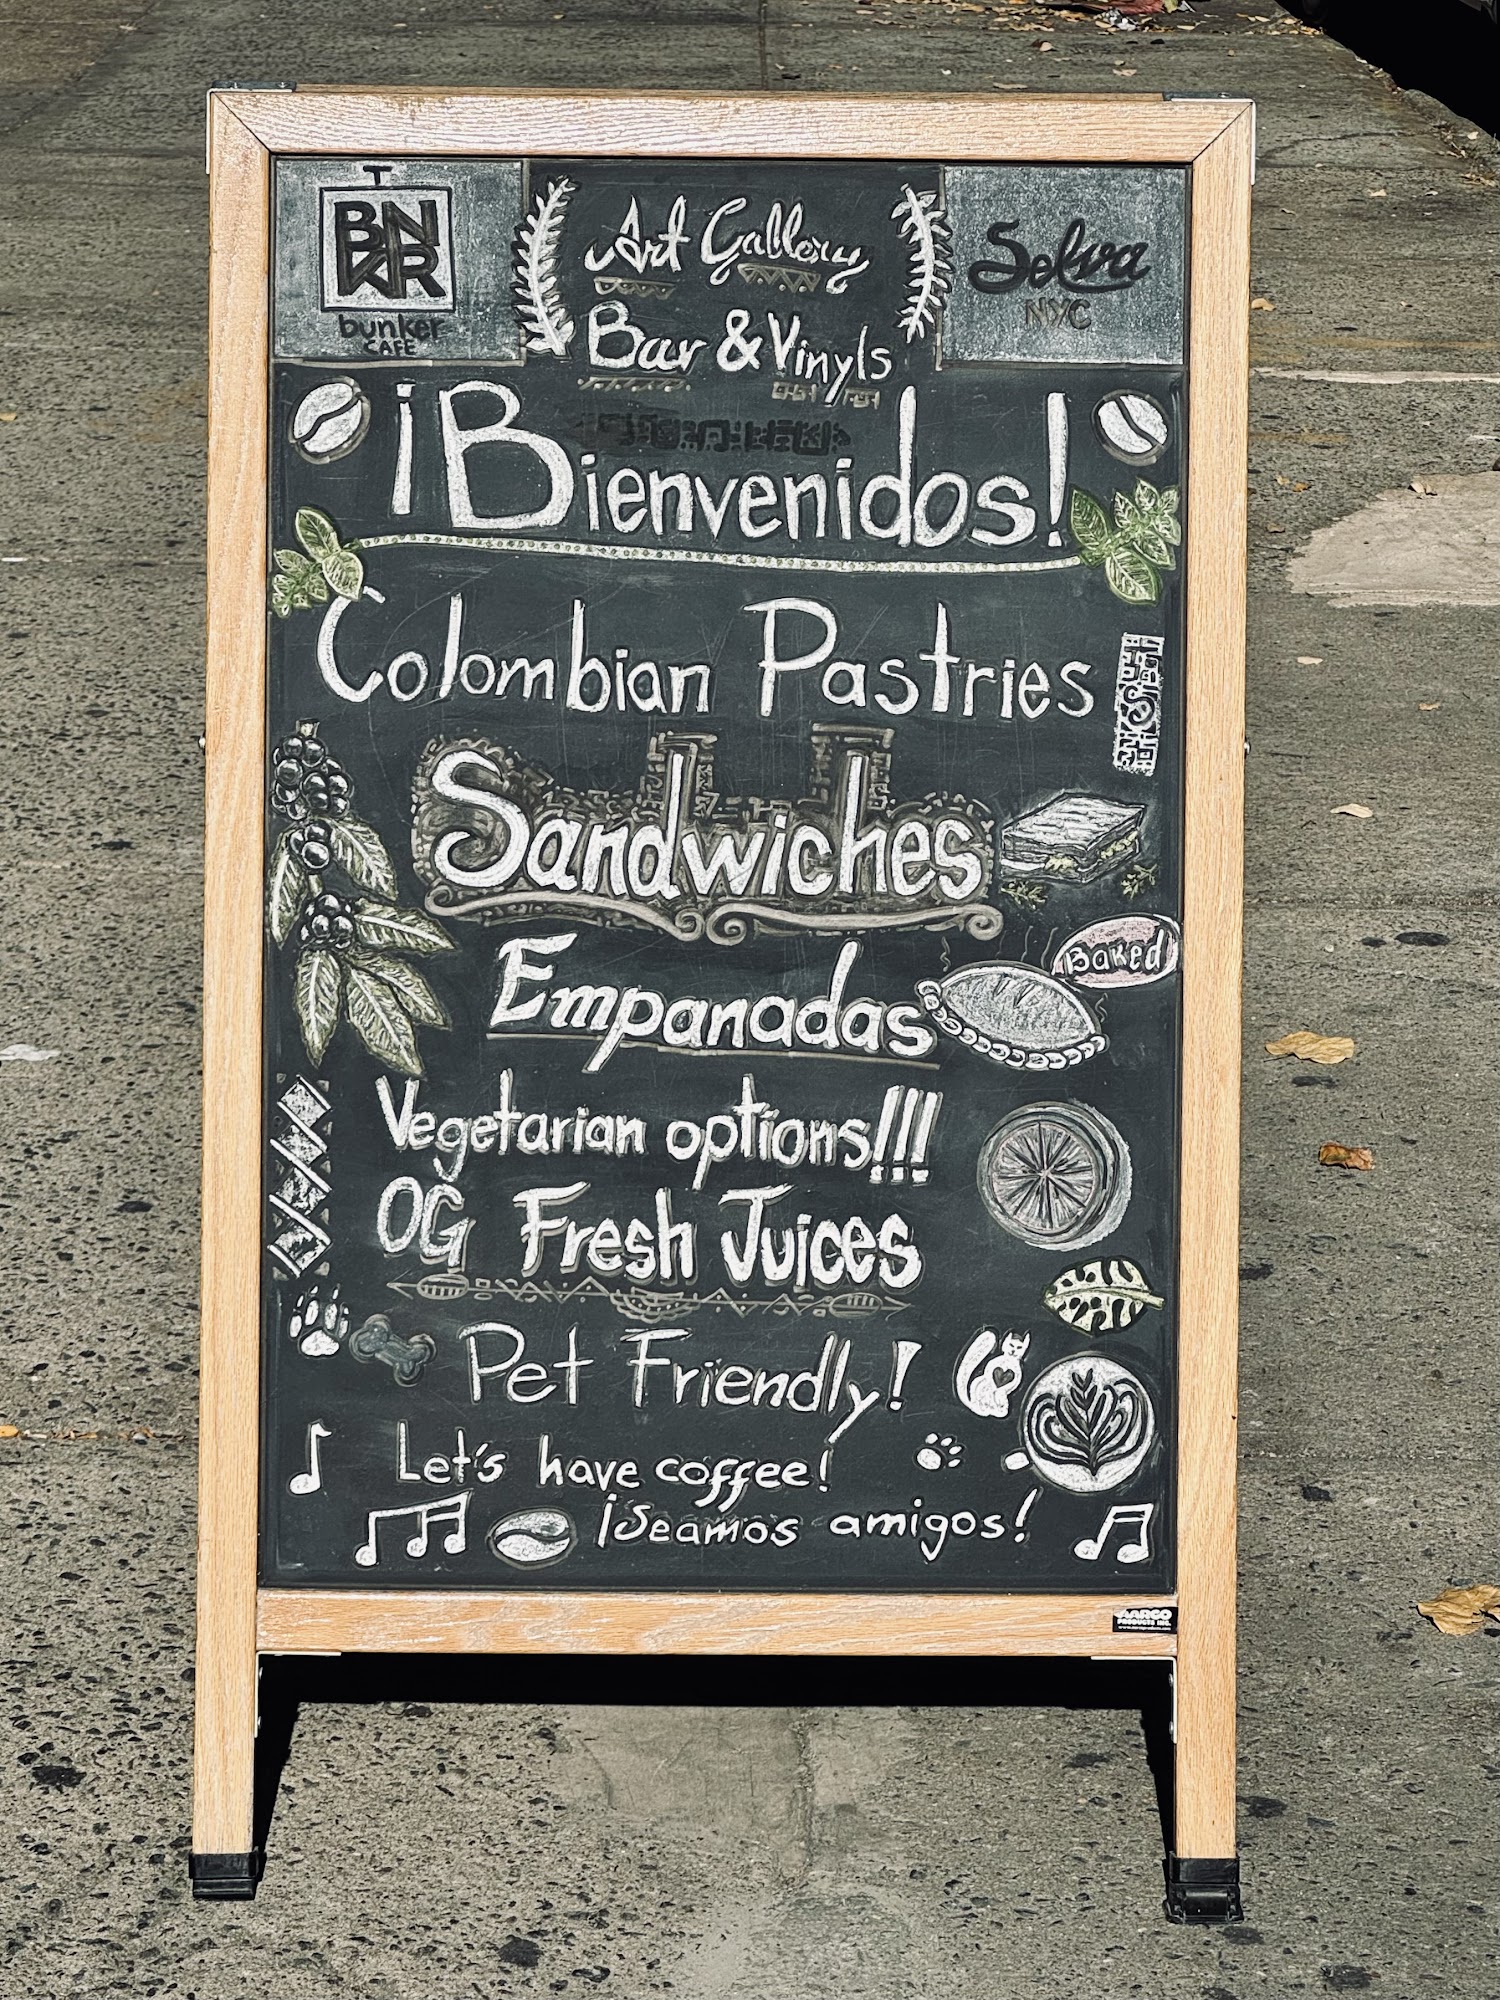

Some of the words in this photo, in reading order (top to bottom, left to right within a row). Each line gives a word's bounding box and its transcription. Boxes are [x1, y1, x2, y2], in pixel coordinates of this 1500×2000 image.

[584, 194, 692, 274] Art
[700, 197, 871, 295] Gallery
[338, 313, 446, 341] bunker
[362, 340, 418, 356] CAFE
[587, 300, 708, 372] Bar
[716, 308, 764, 372] &
[767, 311, 893, 406] Vinyls
[1025, 297, 1093, 330] NYC
[316, 584, 712, 715] Colombian
[743, 596, 1096, 718] Pastries
[430, 747, 985, 900] Sandwiches
[488, 931, 939, 1074] Empanadas
[1065, 928, 1165, 975] Baked
[374, 1068, 647, 1183] Vegetarian
[665, 1073, 944, 1191] options!!!
[376, 1176, 475, 1272] OG
[513, 1181, 699, 1281] Fresh
[718, 1184, 924, 1289] Juices
[458, 1322, 594, 1406] Pet
[621, 1327, 924, 1445] Friendly!
[398, 1421, 507, 1484] Let's
[538, 1433, 642, 1492] have
[653, 1449, 831, 1513] coffee!
[828, 1486, 1040, 1563] amigos!
